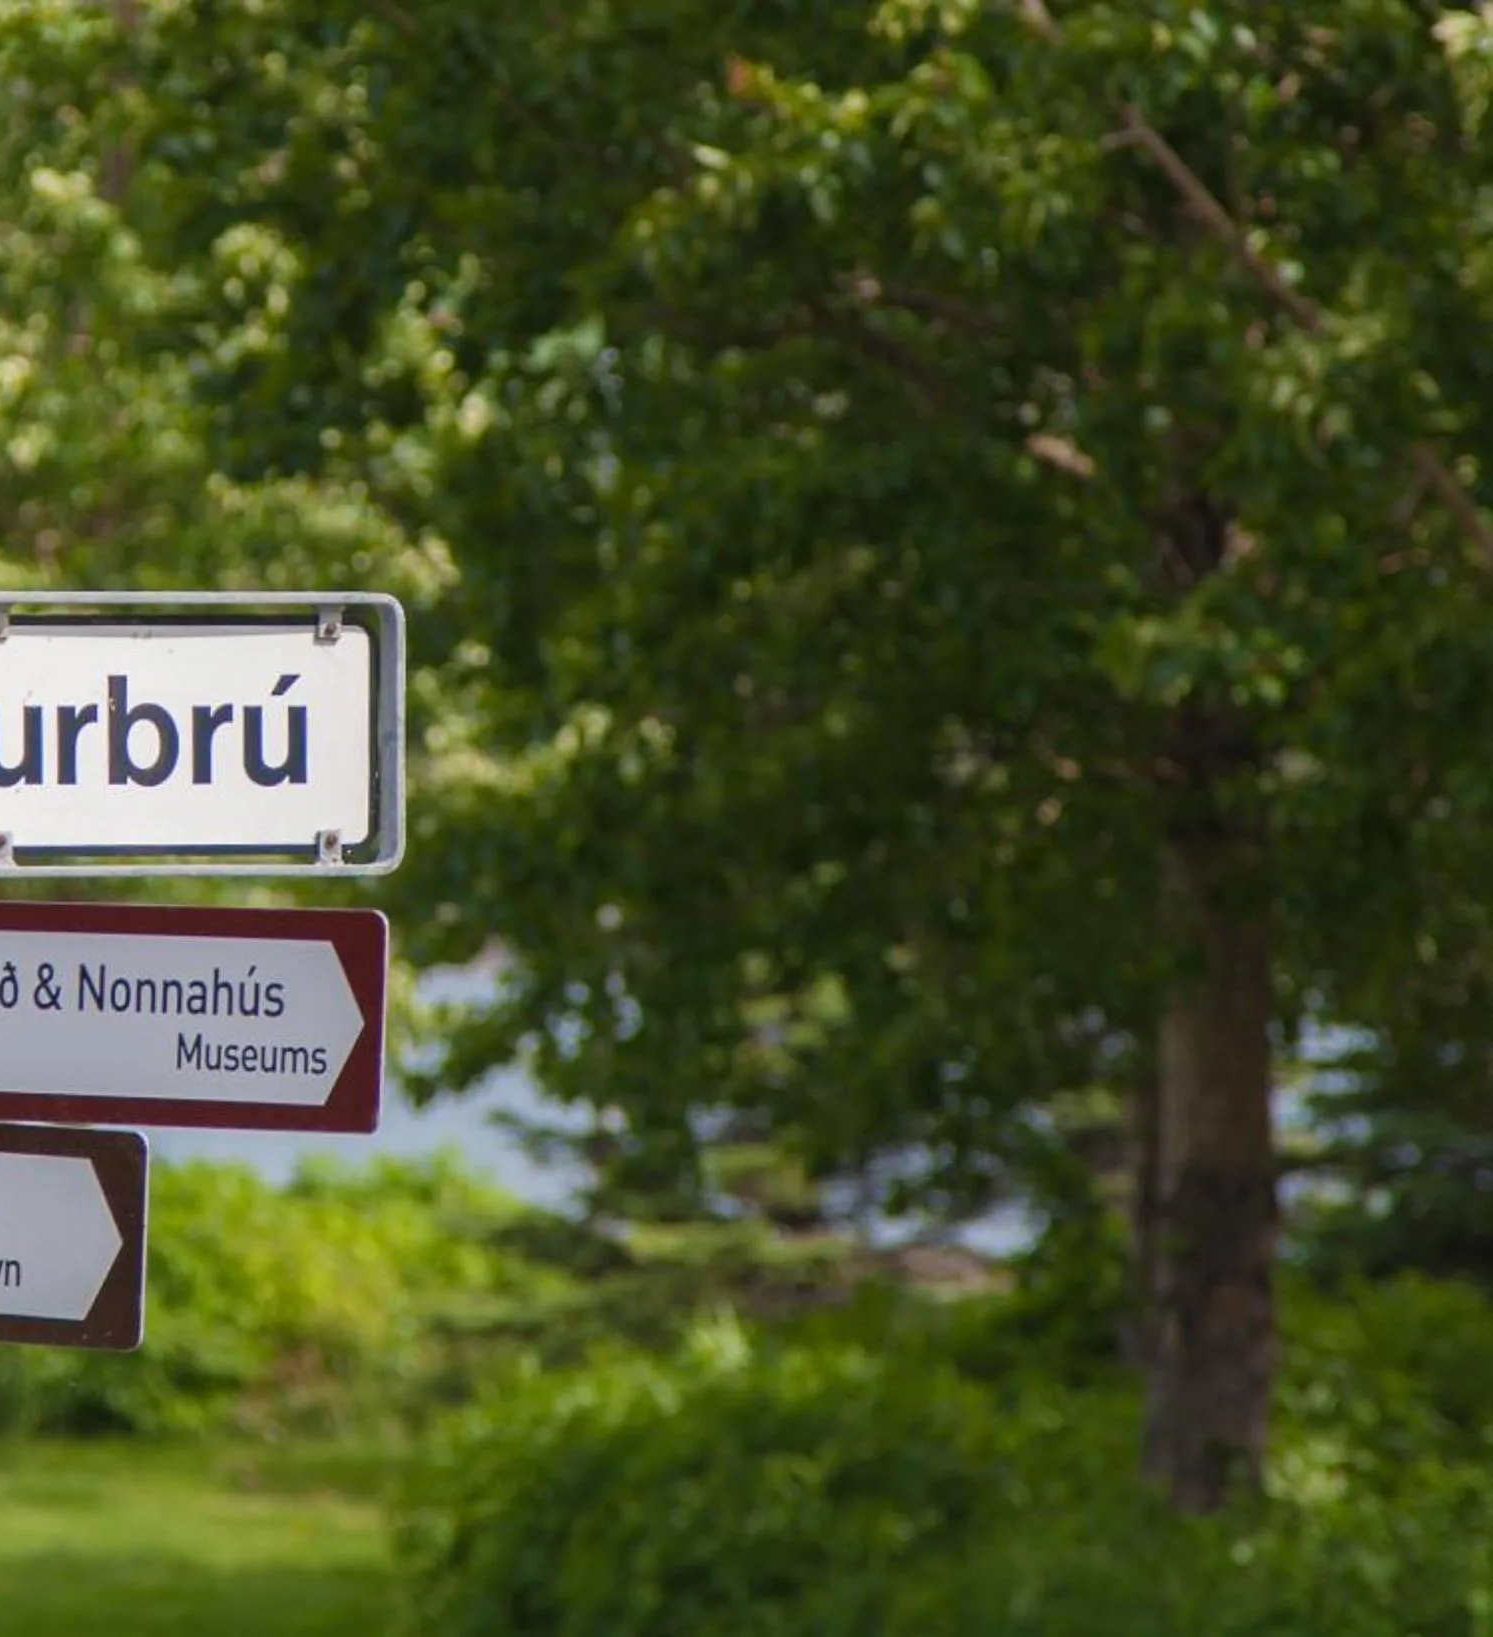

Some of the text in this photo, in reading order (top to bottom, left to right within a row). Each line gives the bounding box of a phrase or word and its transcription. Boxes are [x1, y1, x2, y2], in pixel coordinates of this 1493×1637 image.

[33, 962, 62, 1011] &
[78, 963, 285, 1018] Nonnahús
[176, 1032, 328, 1076] Museums
